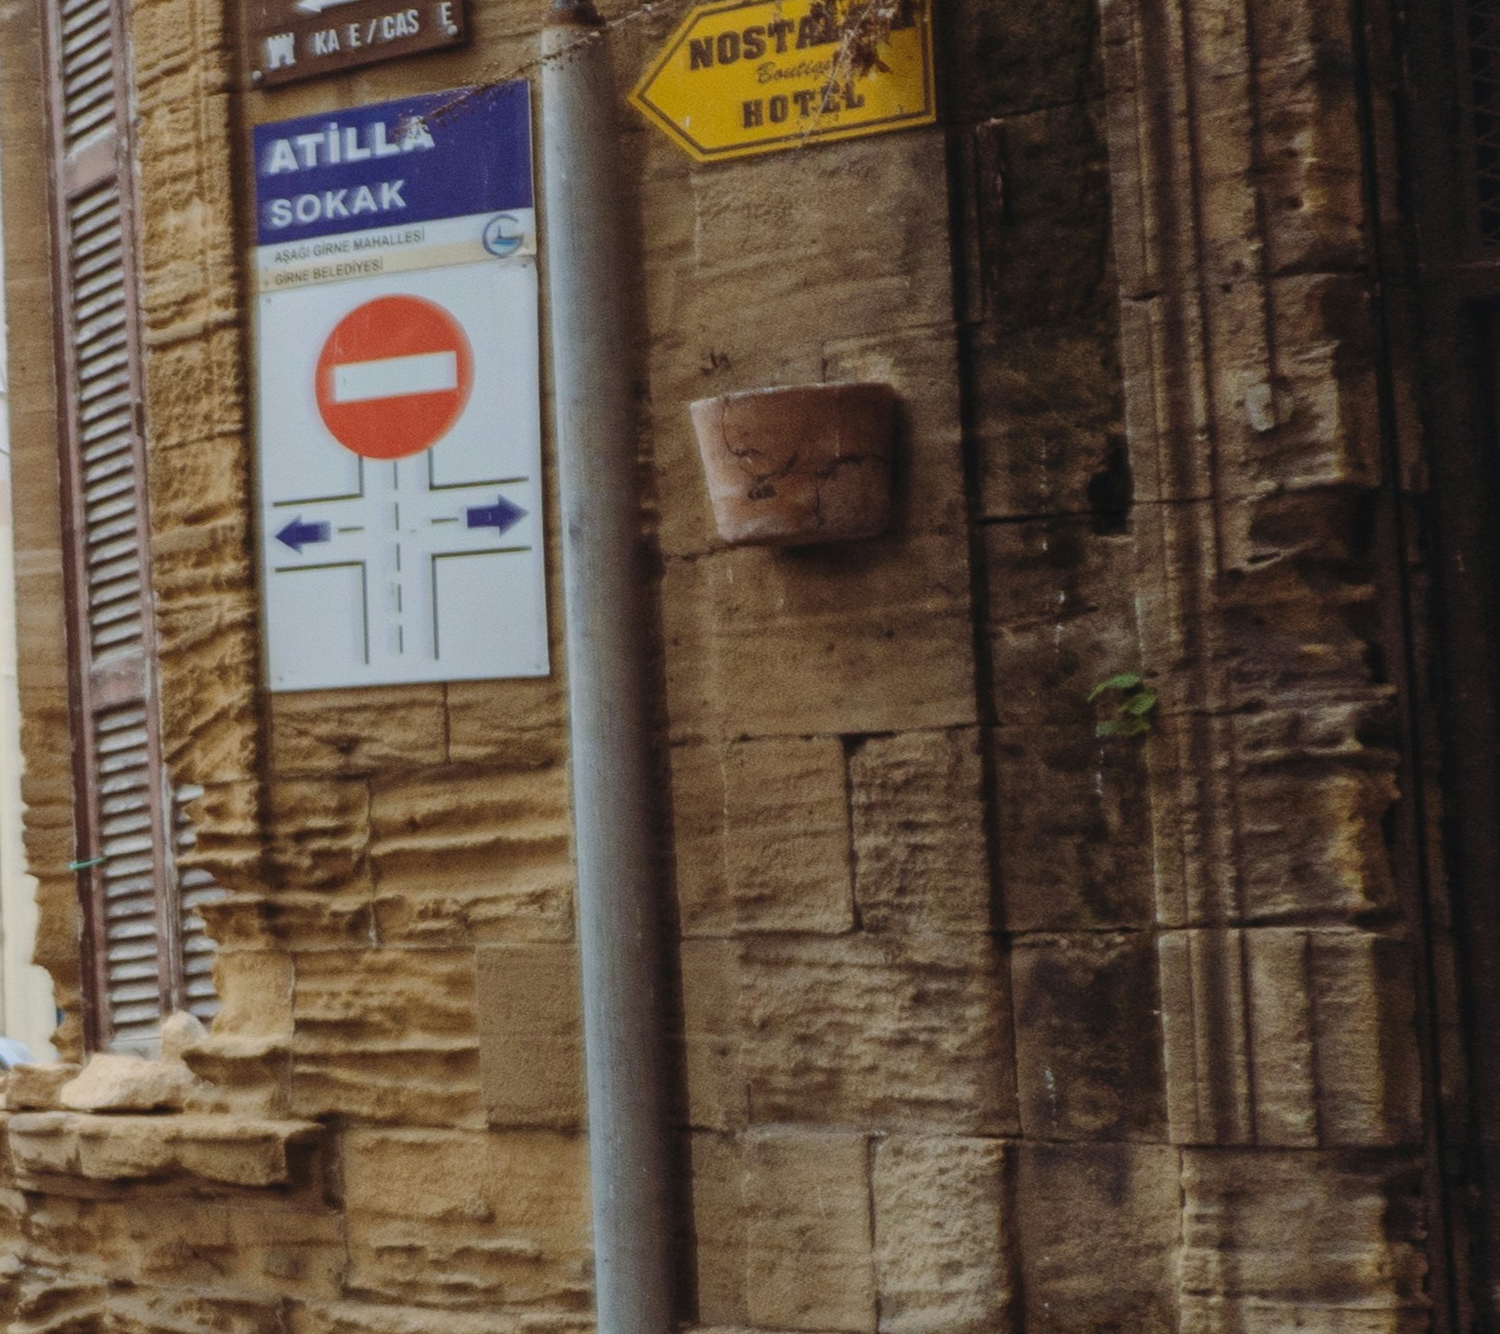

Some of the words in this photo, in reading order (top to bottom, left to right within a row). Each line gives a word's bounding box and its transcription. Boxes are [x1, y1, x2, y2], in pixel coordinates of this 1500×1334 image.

[742, 80, 866, 128] HOTEL
[266, 117, 435, 175] ATİLLA
[269, 180, 407, 228] SOKAK
[313, 240, 349, 257] GİRNE
[353, 228, 425, 251] MAHALLESİ
[274, 269, 310, 286] GİRNE
[312, 256, 383, 278] BELEDİYESİ
